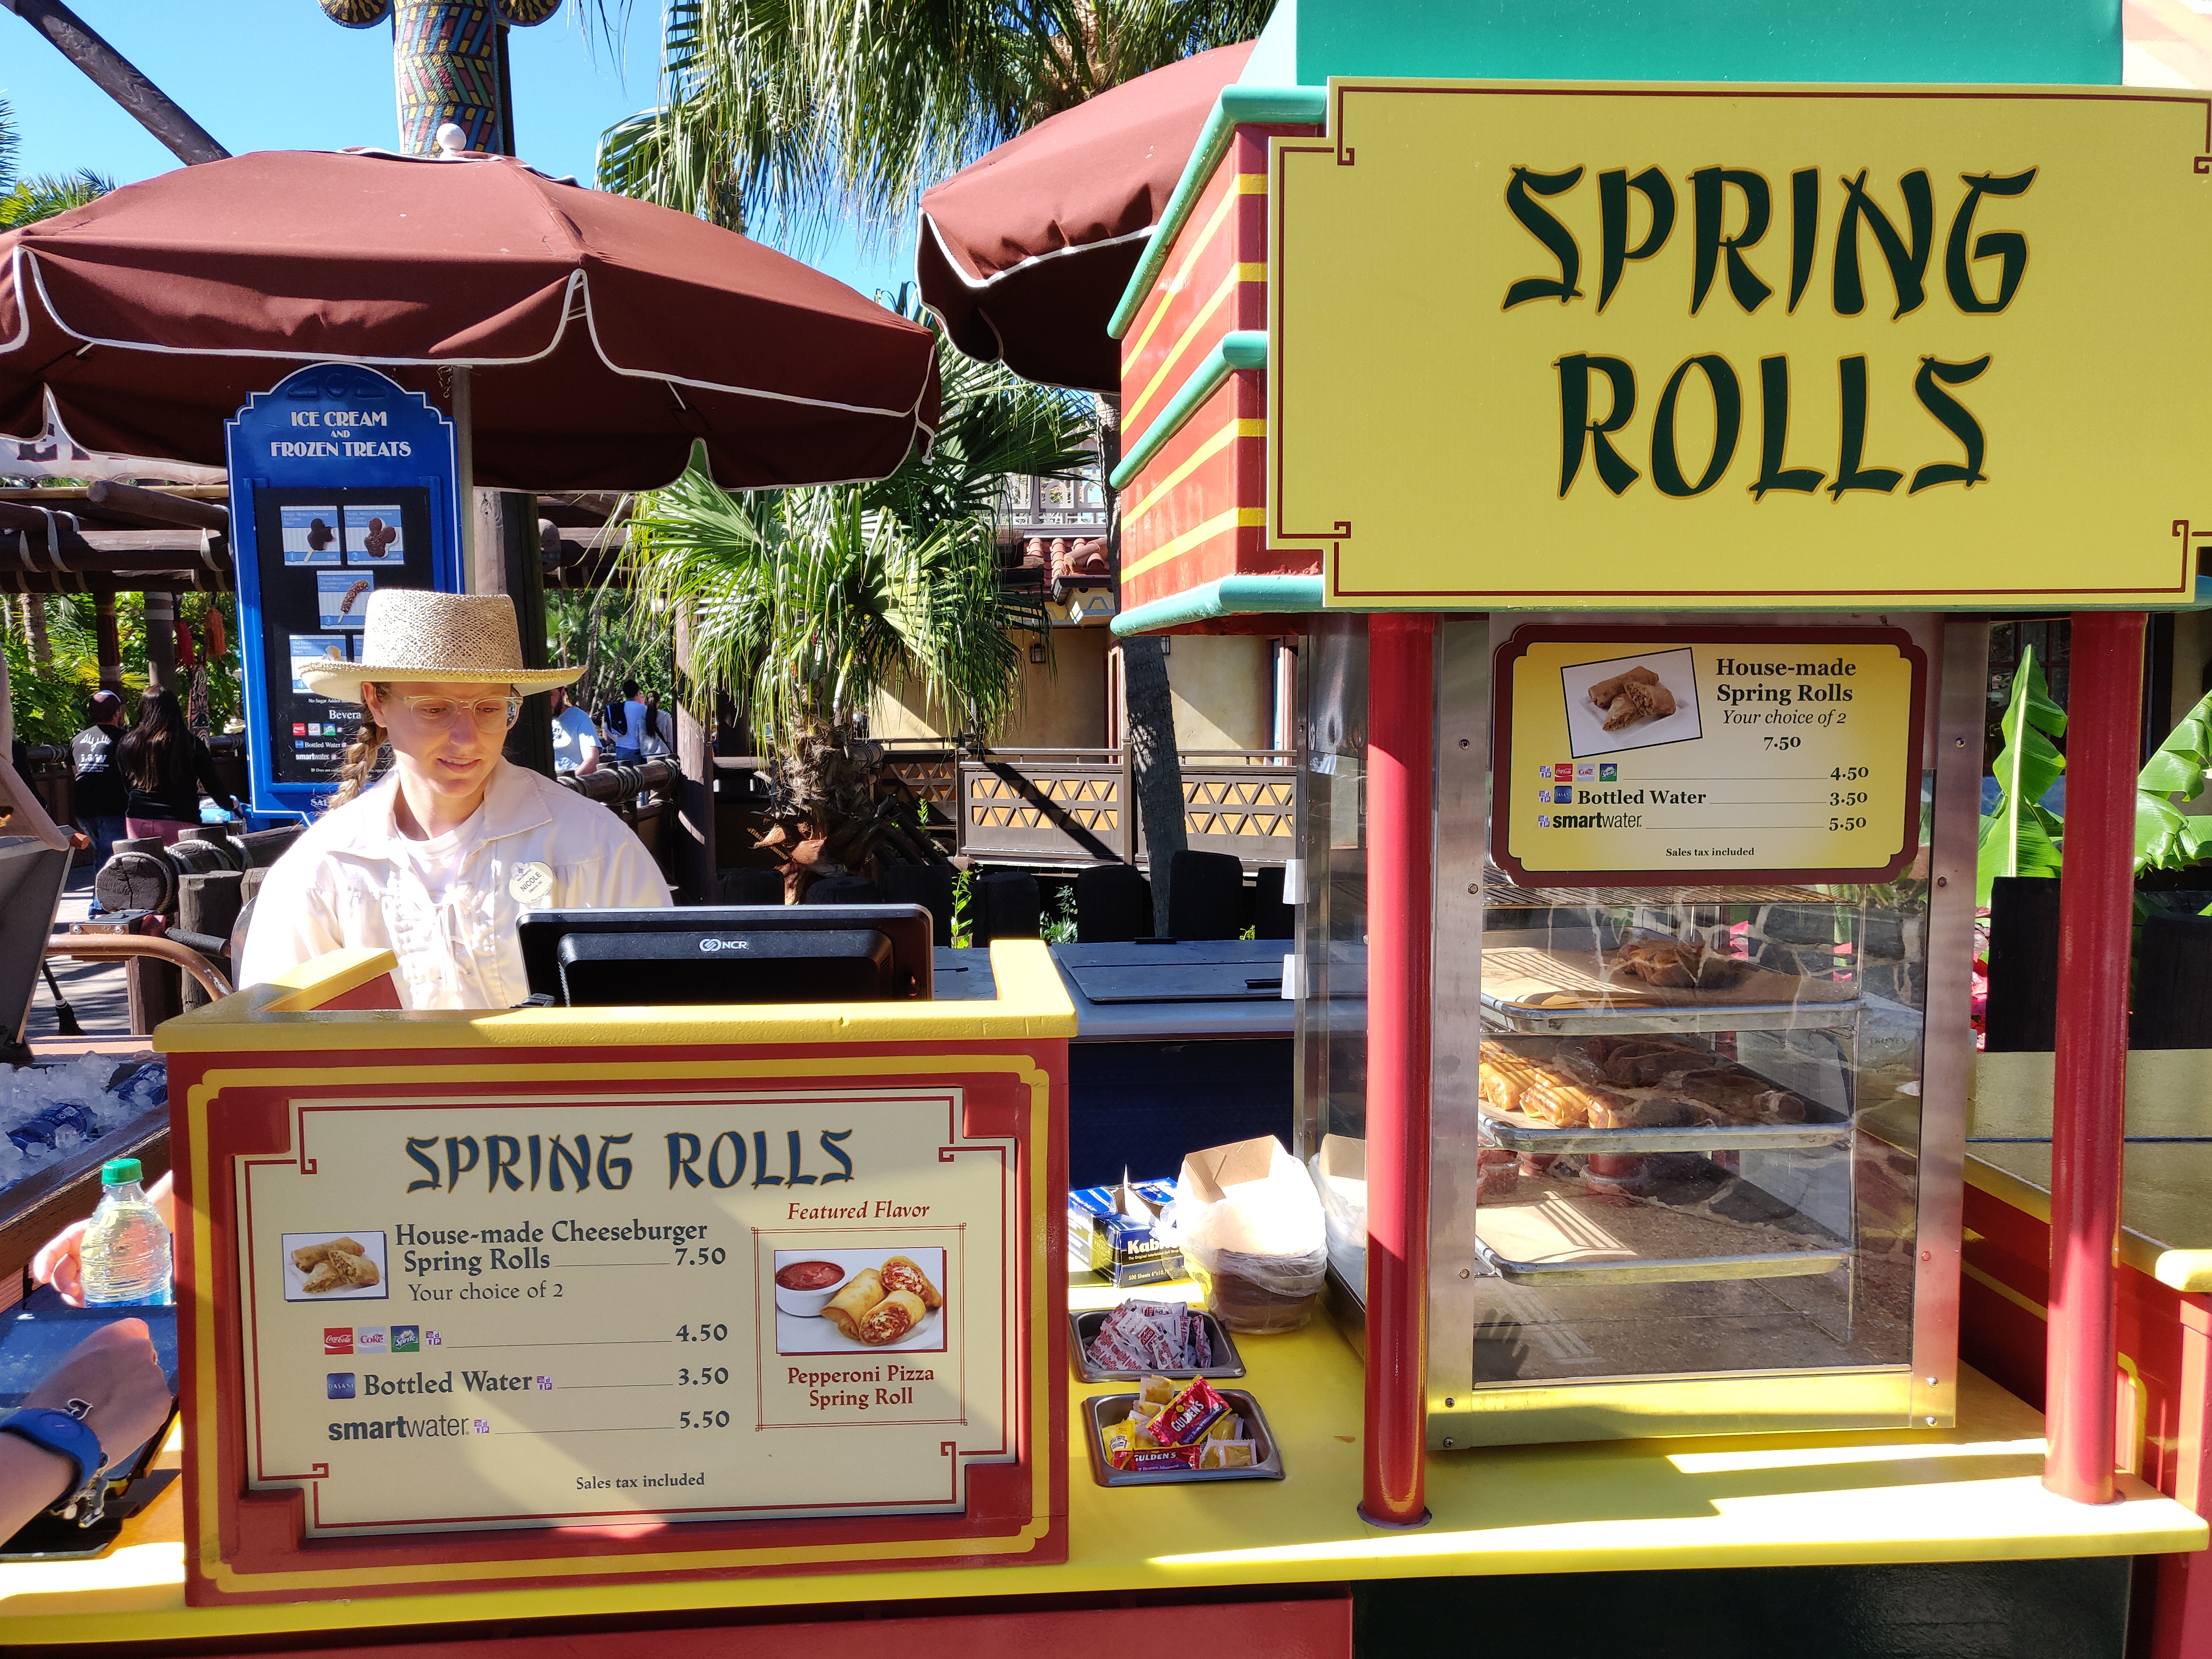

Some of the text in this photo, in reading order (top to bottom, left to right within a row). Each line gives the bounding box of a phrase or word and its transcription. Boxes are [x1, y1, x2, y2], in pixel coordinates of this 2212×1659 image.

[1501, 163, 2040, 322] SPRING
[291, 411, 387, 426] ICE CREAM
[1551, 351, 1994, 504] ROLLS
[271, 441, 411, 457] FROZEN TREATS
[1716, 658, 1856, 677] House-made
[1717, 684, 1853, 705] Spring Rolls
[329, 710, 361, 719] Bevera
[1722, 709, 1846, 728] Your choice of 2
[1764, 736, 1801, 751] 7.50
[1830, 766, 1869, 781] 4.50
[311, 798, 330, 806] SAL
[1577, 789, 1707, 805] Bottled Water
[1829, 792, 1868, 806] 3.50
[1829, 817, 1867, 832] 5.50
[1666, 848, 1692, 856] Sales
[1712, 847, 1755, 856] included
[520, 872, 542, 891] NICOLE
[722, 941, 748, 949] NCR
[405, 1128, 855, 1194] SPRING ROLLS
[787, 1199, 930, 1221] Featured Flavor
[395, 1218, 708, 1247] House-made Cheeseburger
[674, 1248, 726, 1267] 7.50
[1094, 1240, 1111, 1256] PREMIUM
[404, 1247, 550, 1277] Spring Rolls
[408, 1281, 564, 1302] Your choice of 2
[361, 1335, 384, 1344] Coke
[395, 1336, 416, 1347] Sprite
[675, 1323, 728, 1343] 4.50
[364, 1370, 532, 1395] Bottled Water
[678, 1367, 729, 1386] 3.50
[787, 1364, 935, 1387] Pepperoni Pizza
[810, 1387, 914, 1410] Spring Roll
[680, 1410, 730, 1430] 5.50
[1171, 1400, 1204, 1432] GULDEN'S
[576, 1472, 705, 1491] Sales tax included
